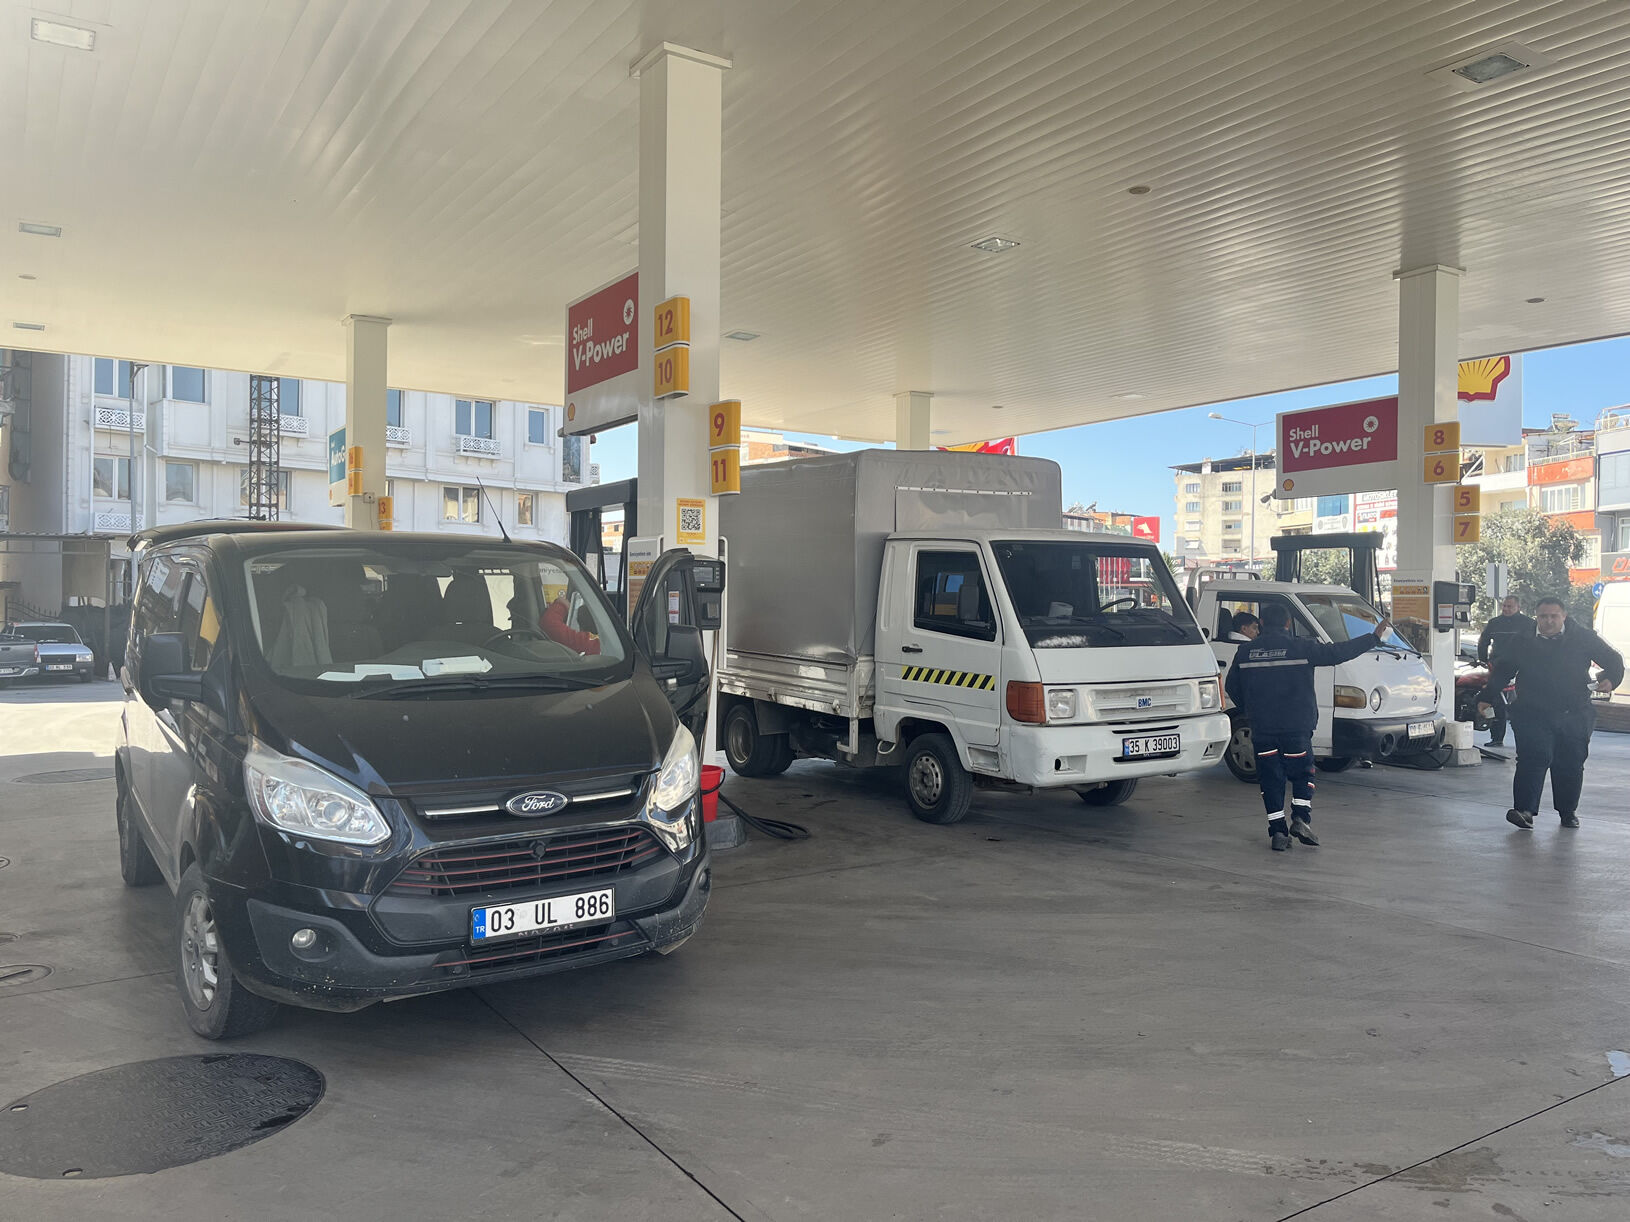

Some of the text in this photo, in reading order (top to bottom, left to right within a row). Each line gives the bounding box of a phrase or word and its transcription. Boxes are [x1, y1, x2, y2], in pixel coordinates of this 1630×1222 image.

[573, 318, 593, 344] Shell
[658, 309, 673, 336] 12
[573, 332, 629, 371] V-Power
[658, 358, 673, 385] 10
[714, 412, 725, 437] 9
[1289, 424, 1319, 441] Shell
[1433, 429, 1445, 446] 8
[1289, 436, 1372, 459] V-Power
[713, 459, 727, 483] 11
[1433, 460, 1445, 477] 6
[1459, 491, 1471, 507] 5
[1459, 521, 1471, 537] 7
[1138, 698, 1151, 708] BMC
[1129, 737, 1178, 754] 35 K 39003
[522, 795, 554, 811] Ford
[490, 908, 515, 933] 03
[535, 902, 558, 925] UL
[575, 893, 609, 919] 886
[475, 925, 485, 934] TR
